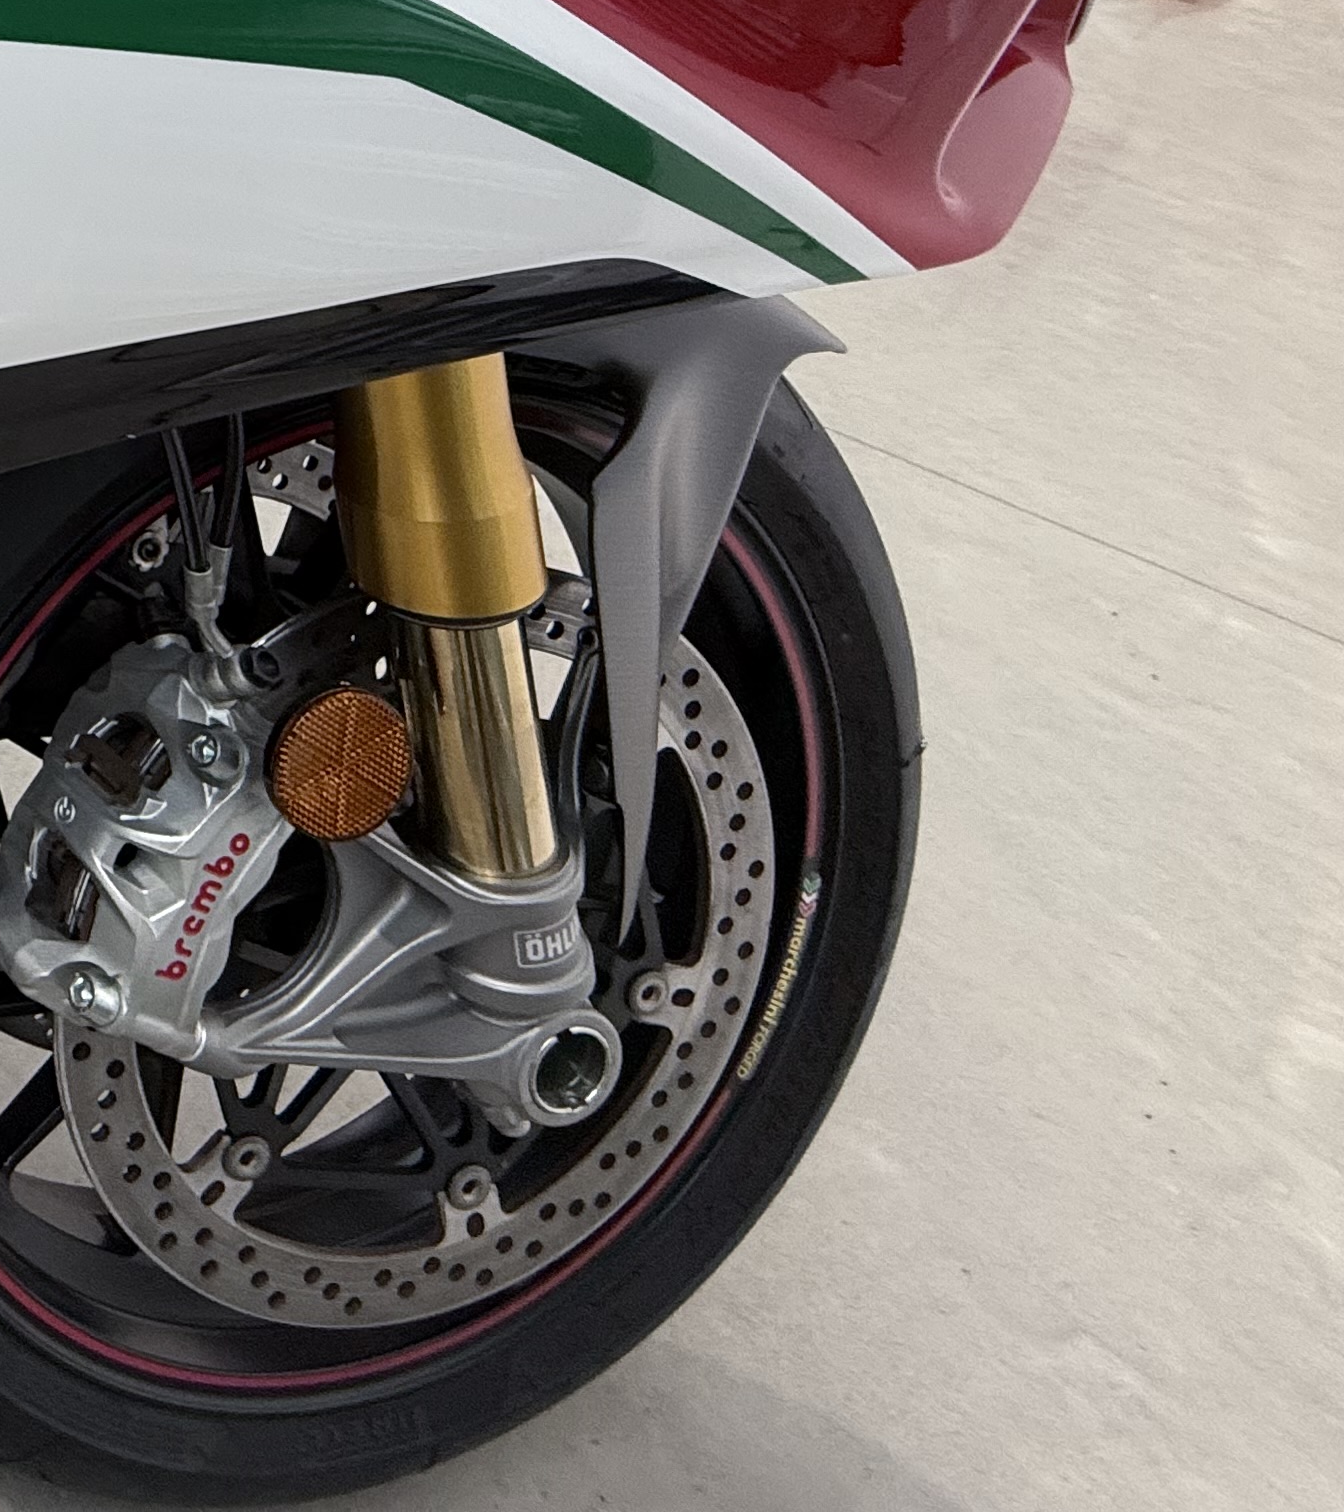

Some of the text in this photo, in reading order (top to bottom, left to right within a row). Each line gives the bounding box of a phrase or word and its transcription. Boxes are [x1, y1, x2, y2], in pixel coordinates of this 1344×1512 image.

[154, 832, 251, 982] brembo
[523, 916, 579, 962] ÖHLI
[761, 916, 808, 1028] marchesini
